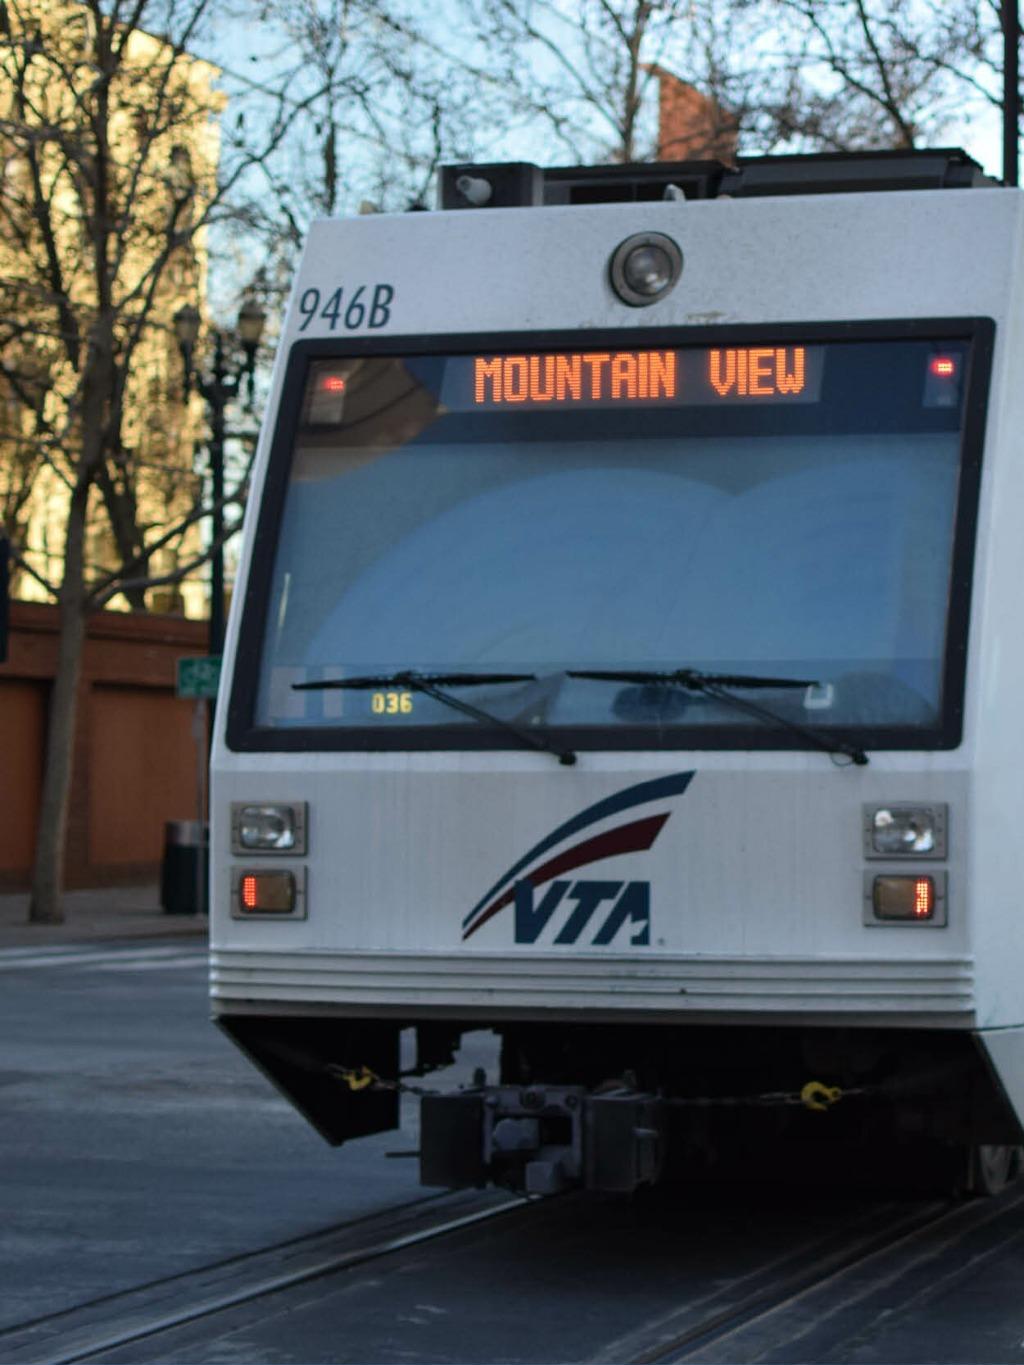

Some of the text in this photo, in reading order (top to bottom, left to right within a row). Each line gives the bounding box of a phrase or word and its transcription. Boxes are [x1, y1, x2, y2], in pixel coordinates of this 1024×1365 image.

[298, 284, 395, 332] 946B
[474, 347, 805, 403] MOUNTAIN VIEW
[372, 692, 413, 714] 036
[514, 879, 651, 946] VTA
